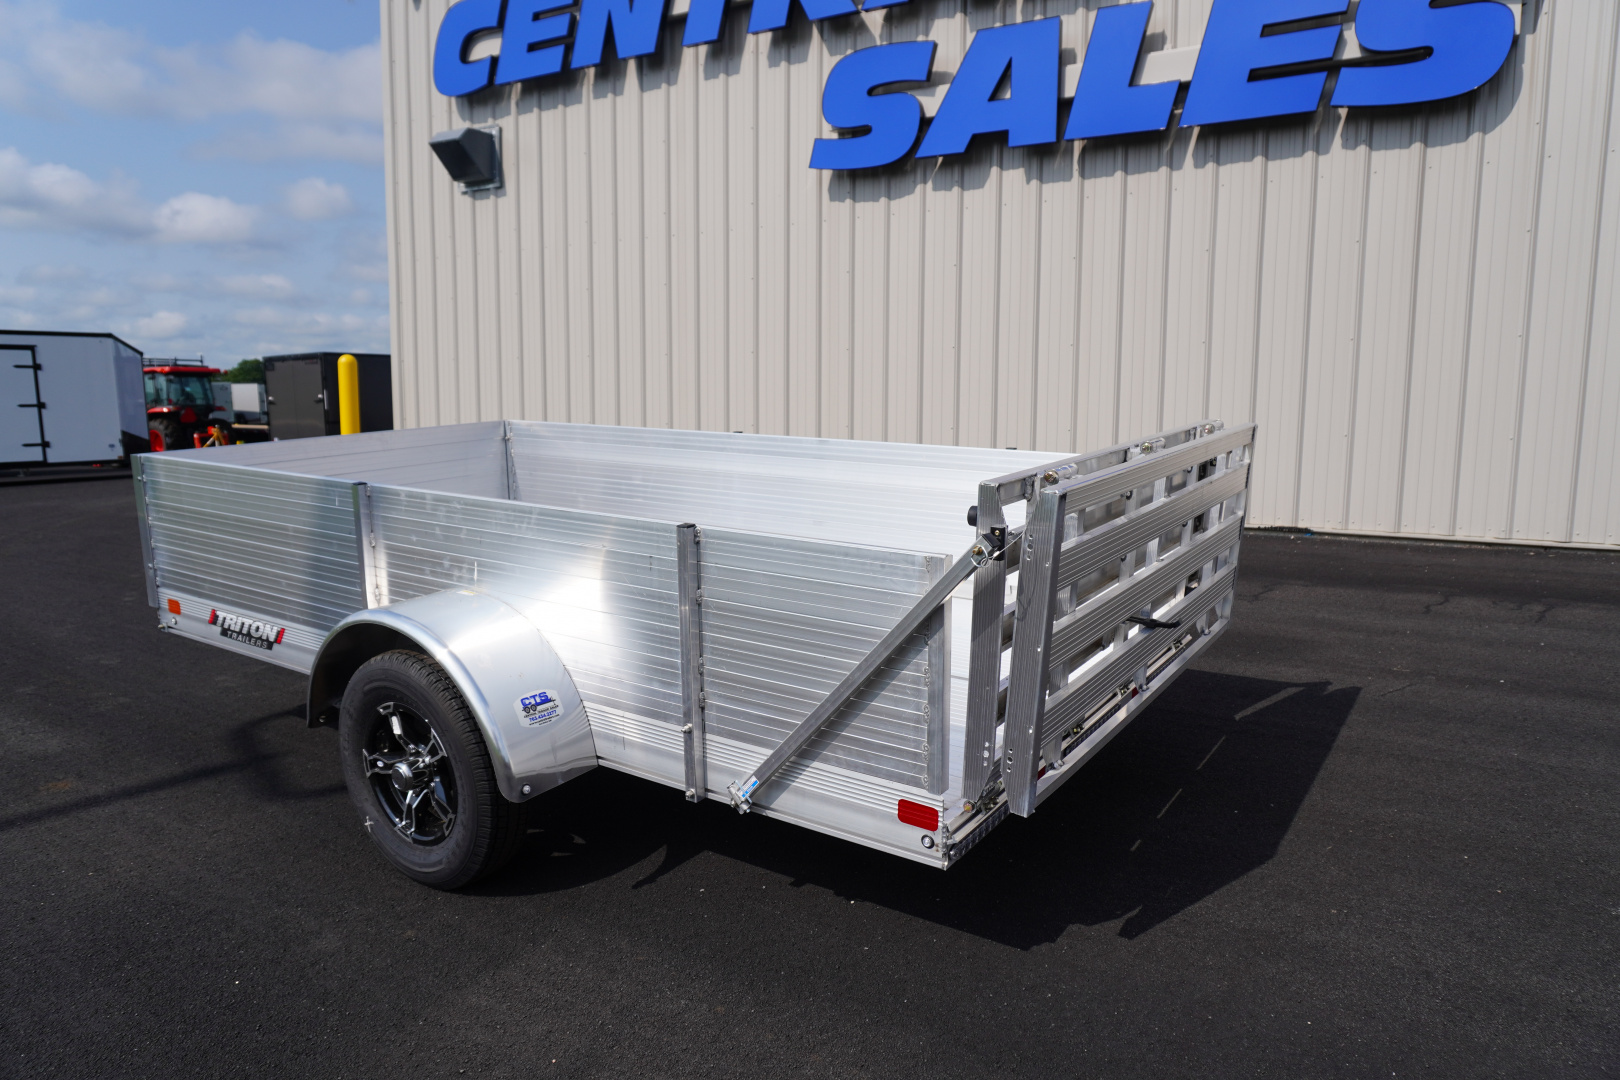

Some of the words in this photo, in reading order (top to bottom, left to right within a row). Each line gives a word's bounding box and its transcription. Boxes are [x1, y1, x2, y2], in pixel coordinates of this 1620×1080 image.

[809, 0, 1516, 170] SALES
[215, 610, 278, 643] TRITON
[226, 631, 268, 649] TRAILERS
[520, 692, 549, 707] CTS
